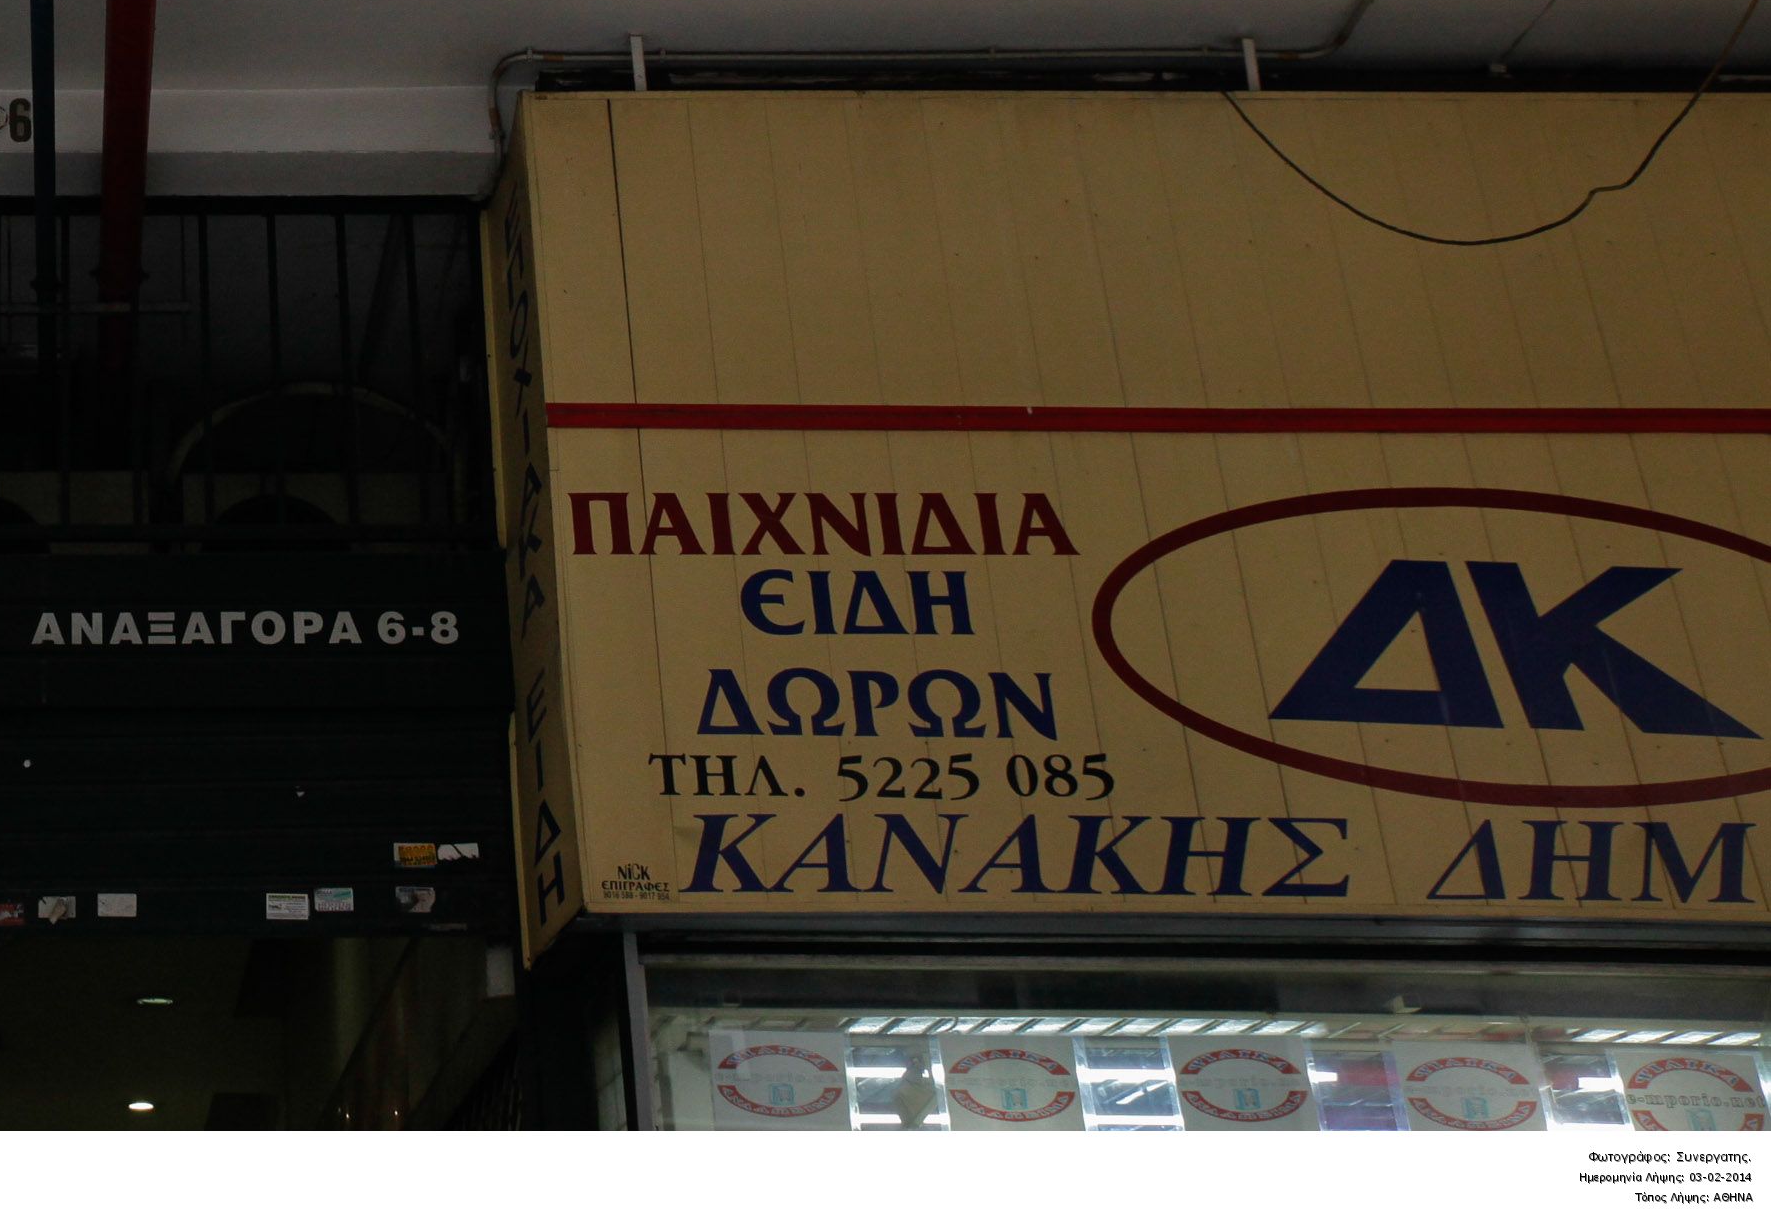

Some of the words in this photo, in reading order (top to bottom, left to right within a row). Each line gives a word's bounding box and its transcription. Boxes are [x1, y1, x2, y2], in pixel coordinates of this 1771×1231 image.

[567, 492, 1081, 556] ΠΑΙΧΝΙΔΙΑ
[31, 610, 363, 645] ΑΝΑΞΑΓΟΡΑ
[377, 610, 460, 645] 6-8
[740, 569, 976, 636] ΕΙΔΗ
[1269, 559, 1765, 739] ΔΚ
[696, 667, 1058, 741] ΔΩΡΩΝ
[527, 667, 565, 926] ΕΙΔΗ
[648, 753, 806, 797] ΤΗΛ.
[837, 754, 980, 802] 5225
[1006, 753, 1115, 801] 085
[677, 813, 1350, 898] ΚΑΝΑΚΗΣ
[1426, 819, 1757, 903] ΔΗΜ
